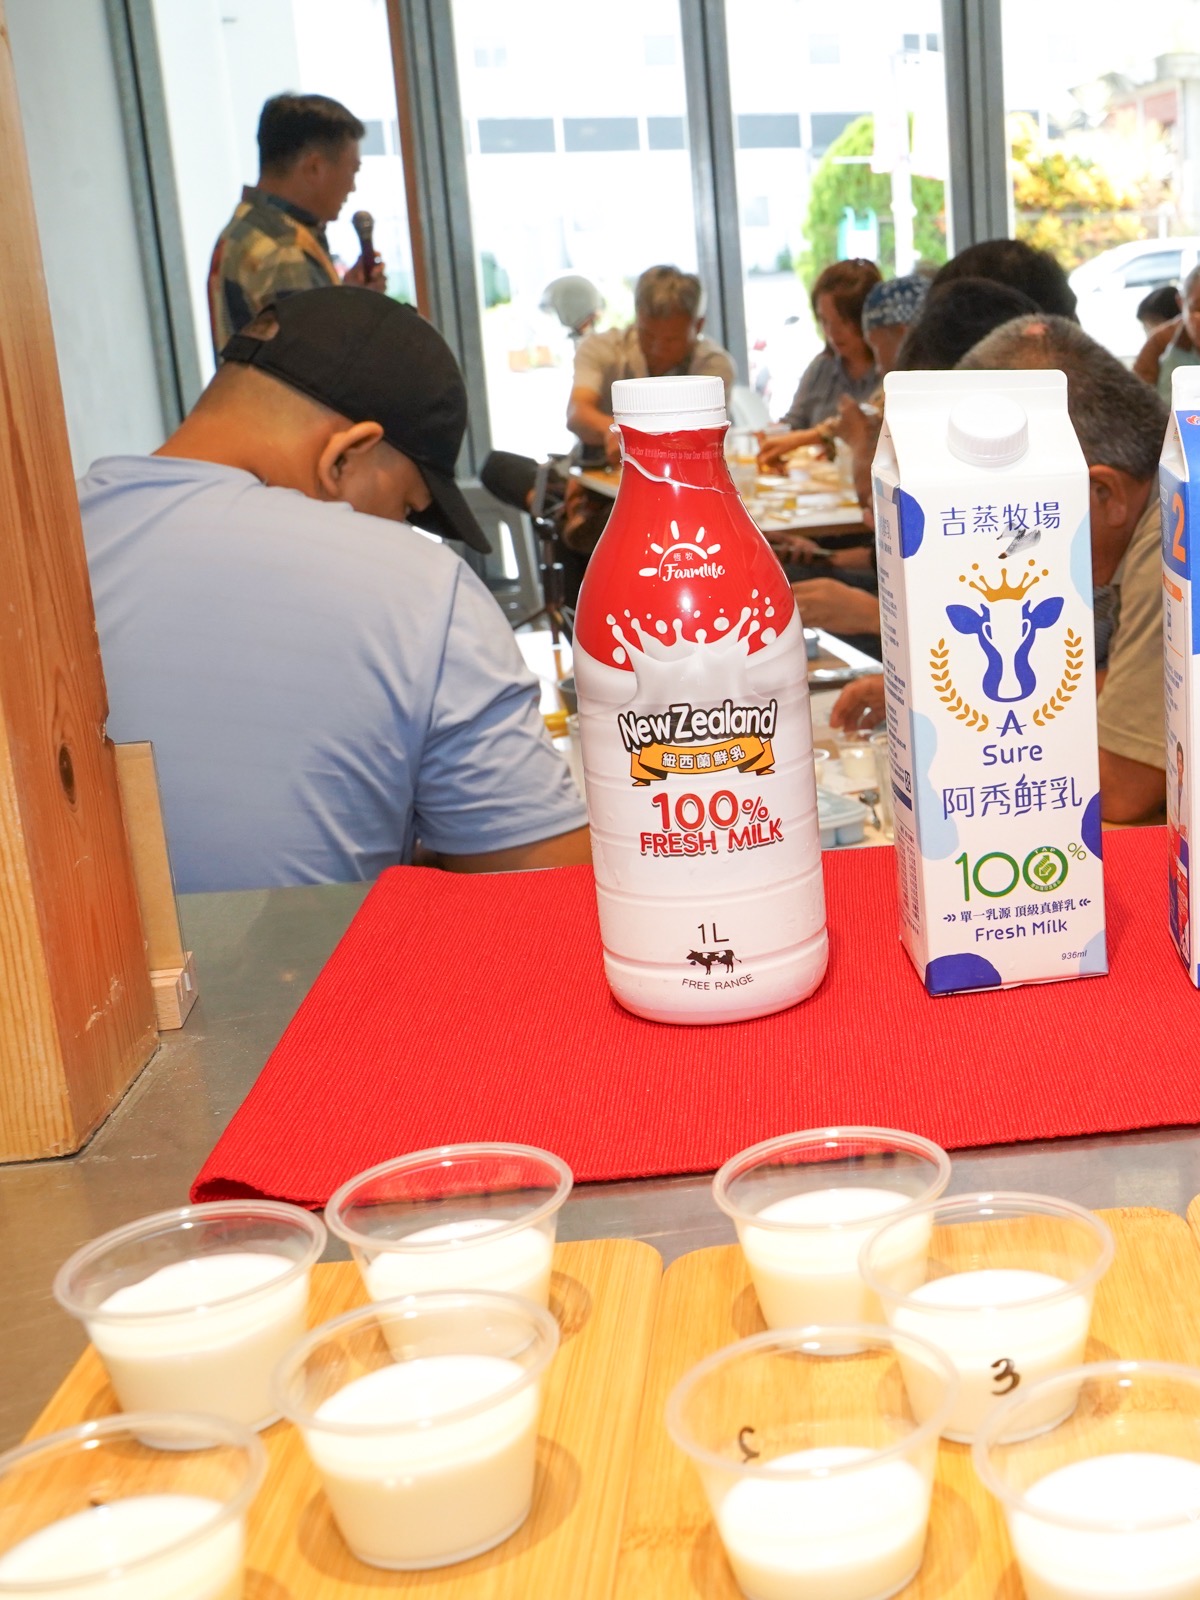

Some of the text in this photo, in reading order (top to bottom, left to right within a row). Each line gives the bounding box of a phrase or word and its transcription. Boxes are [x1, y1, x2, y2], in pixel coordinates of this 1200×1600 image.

[940, 501, 1061, 536] 吉蒸牧場
[1172, 492, 1186, 563] 2
[662, 562, 726, 582] Farmlife
[661, 744, 746, 770] 紐西蘭鮮乳
[982, 744, 1043, 766] Sure
[942, 773, 1083, 821] 阿秀鮮乳
[652, 790, 770, 833] 100%
[640, 818, 785, 857] FRESH MILK
[960, 899, 1077, 923] 單一乳源 頂級真鮮乳
[975, 919, 1068, 942] Fresh Milk
[1061, 949, 1088, 961] 936ml
[681, 973, 754, 991] FREE RANGE
[990, 1358, 1021, 1396] 3
